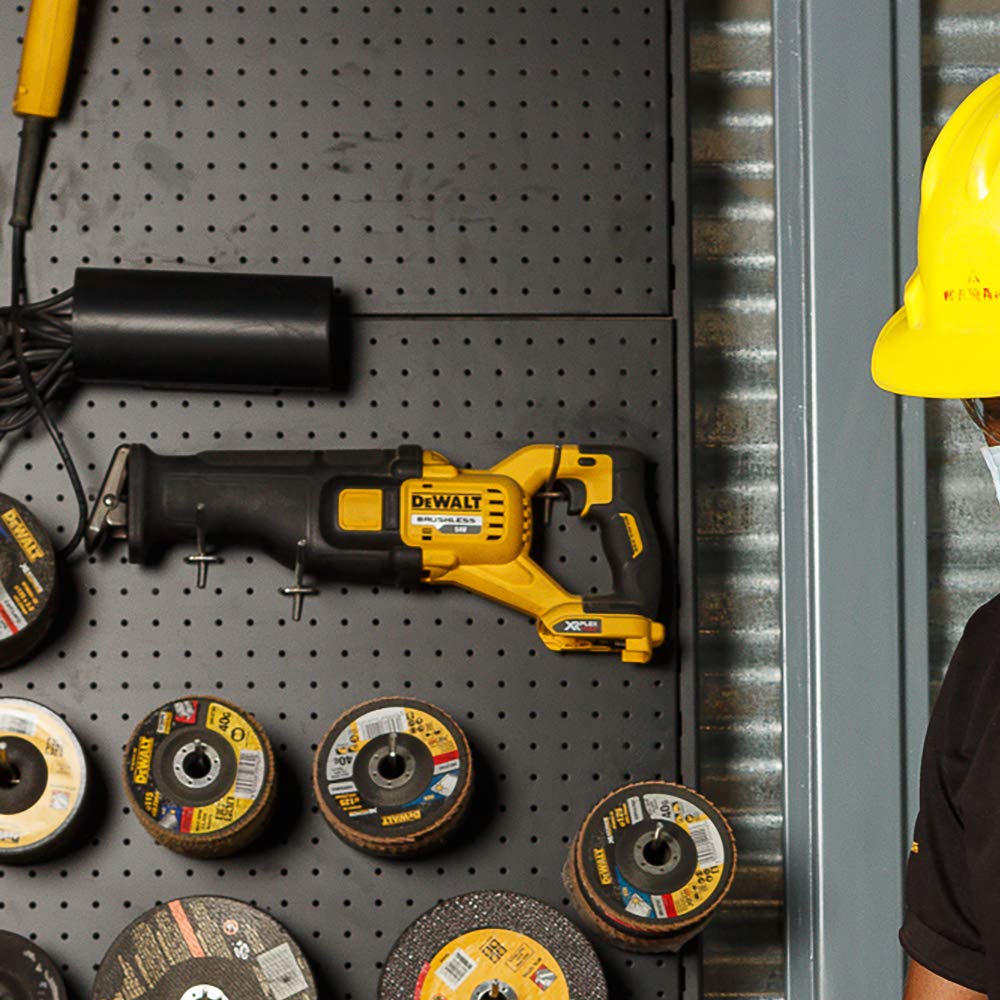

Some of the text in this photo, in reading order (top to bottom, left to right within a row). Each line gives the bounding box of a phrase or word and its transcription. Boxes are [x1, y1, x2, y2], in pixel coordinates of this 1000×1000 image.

[412, 494, 482, 510] DEWALT
[417, 516, 476, 524] BRUSHLESS
[2, 508, 45, 562] DEWALT
[134, 736, 154, 785] DEWALT
[381, 809, 422, 827] DEWALT
[593, 848, 613, 885] DEWALT
